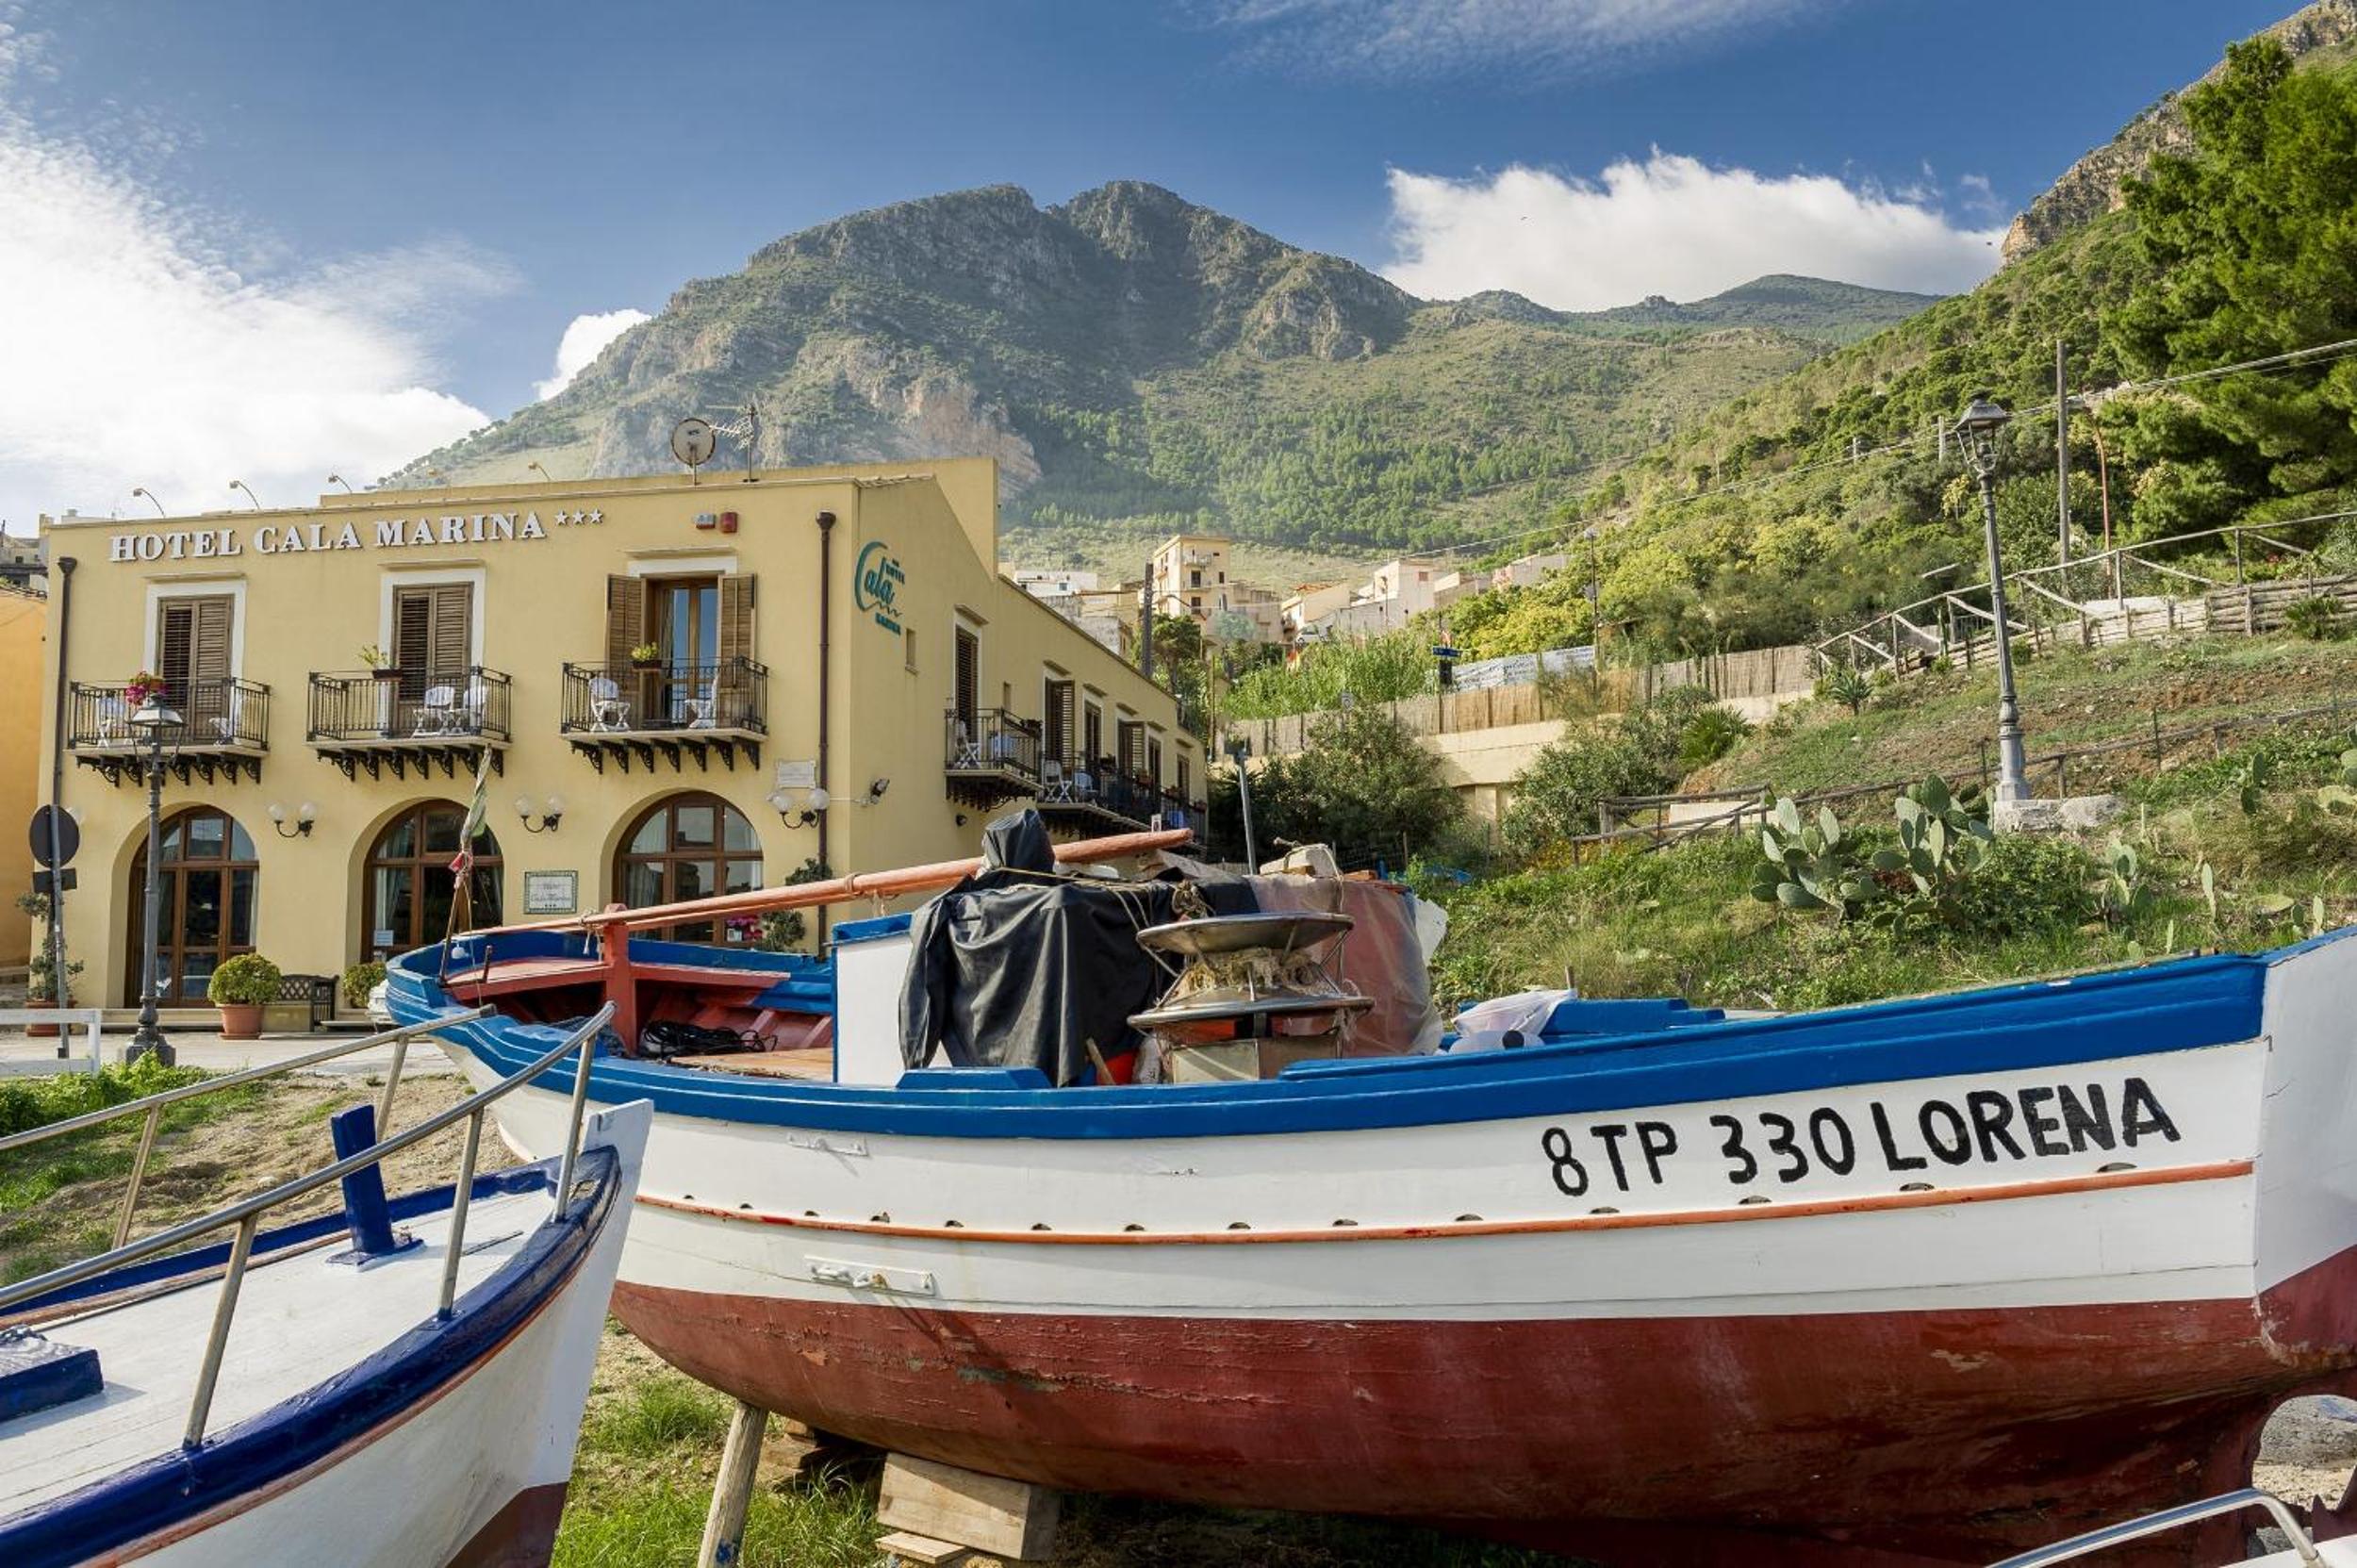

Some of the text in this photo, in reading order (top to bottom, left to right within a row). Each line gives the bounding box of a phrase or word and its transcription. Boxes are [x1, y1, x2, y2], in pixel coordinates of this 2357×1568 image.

[109, 510, 547, 563] HOTEL CALA MARINA
[1709, 1107, 1855, 1184] 330
[1871, 1077, 2182, 1171] LORENA
